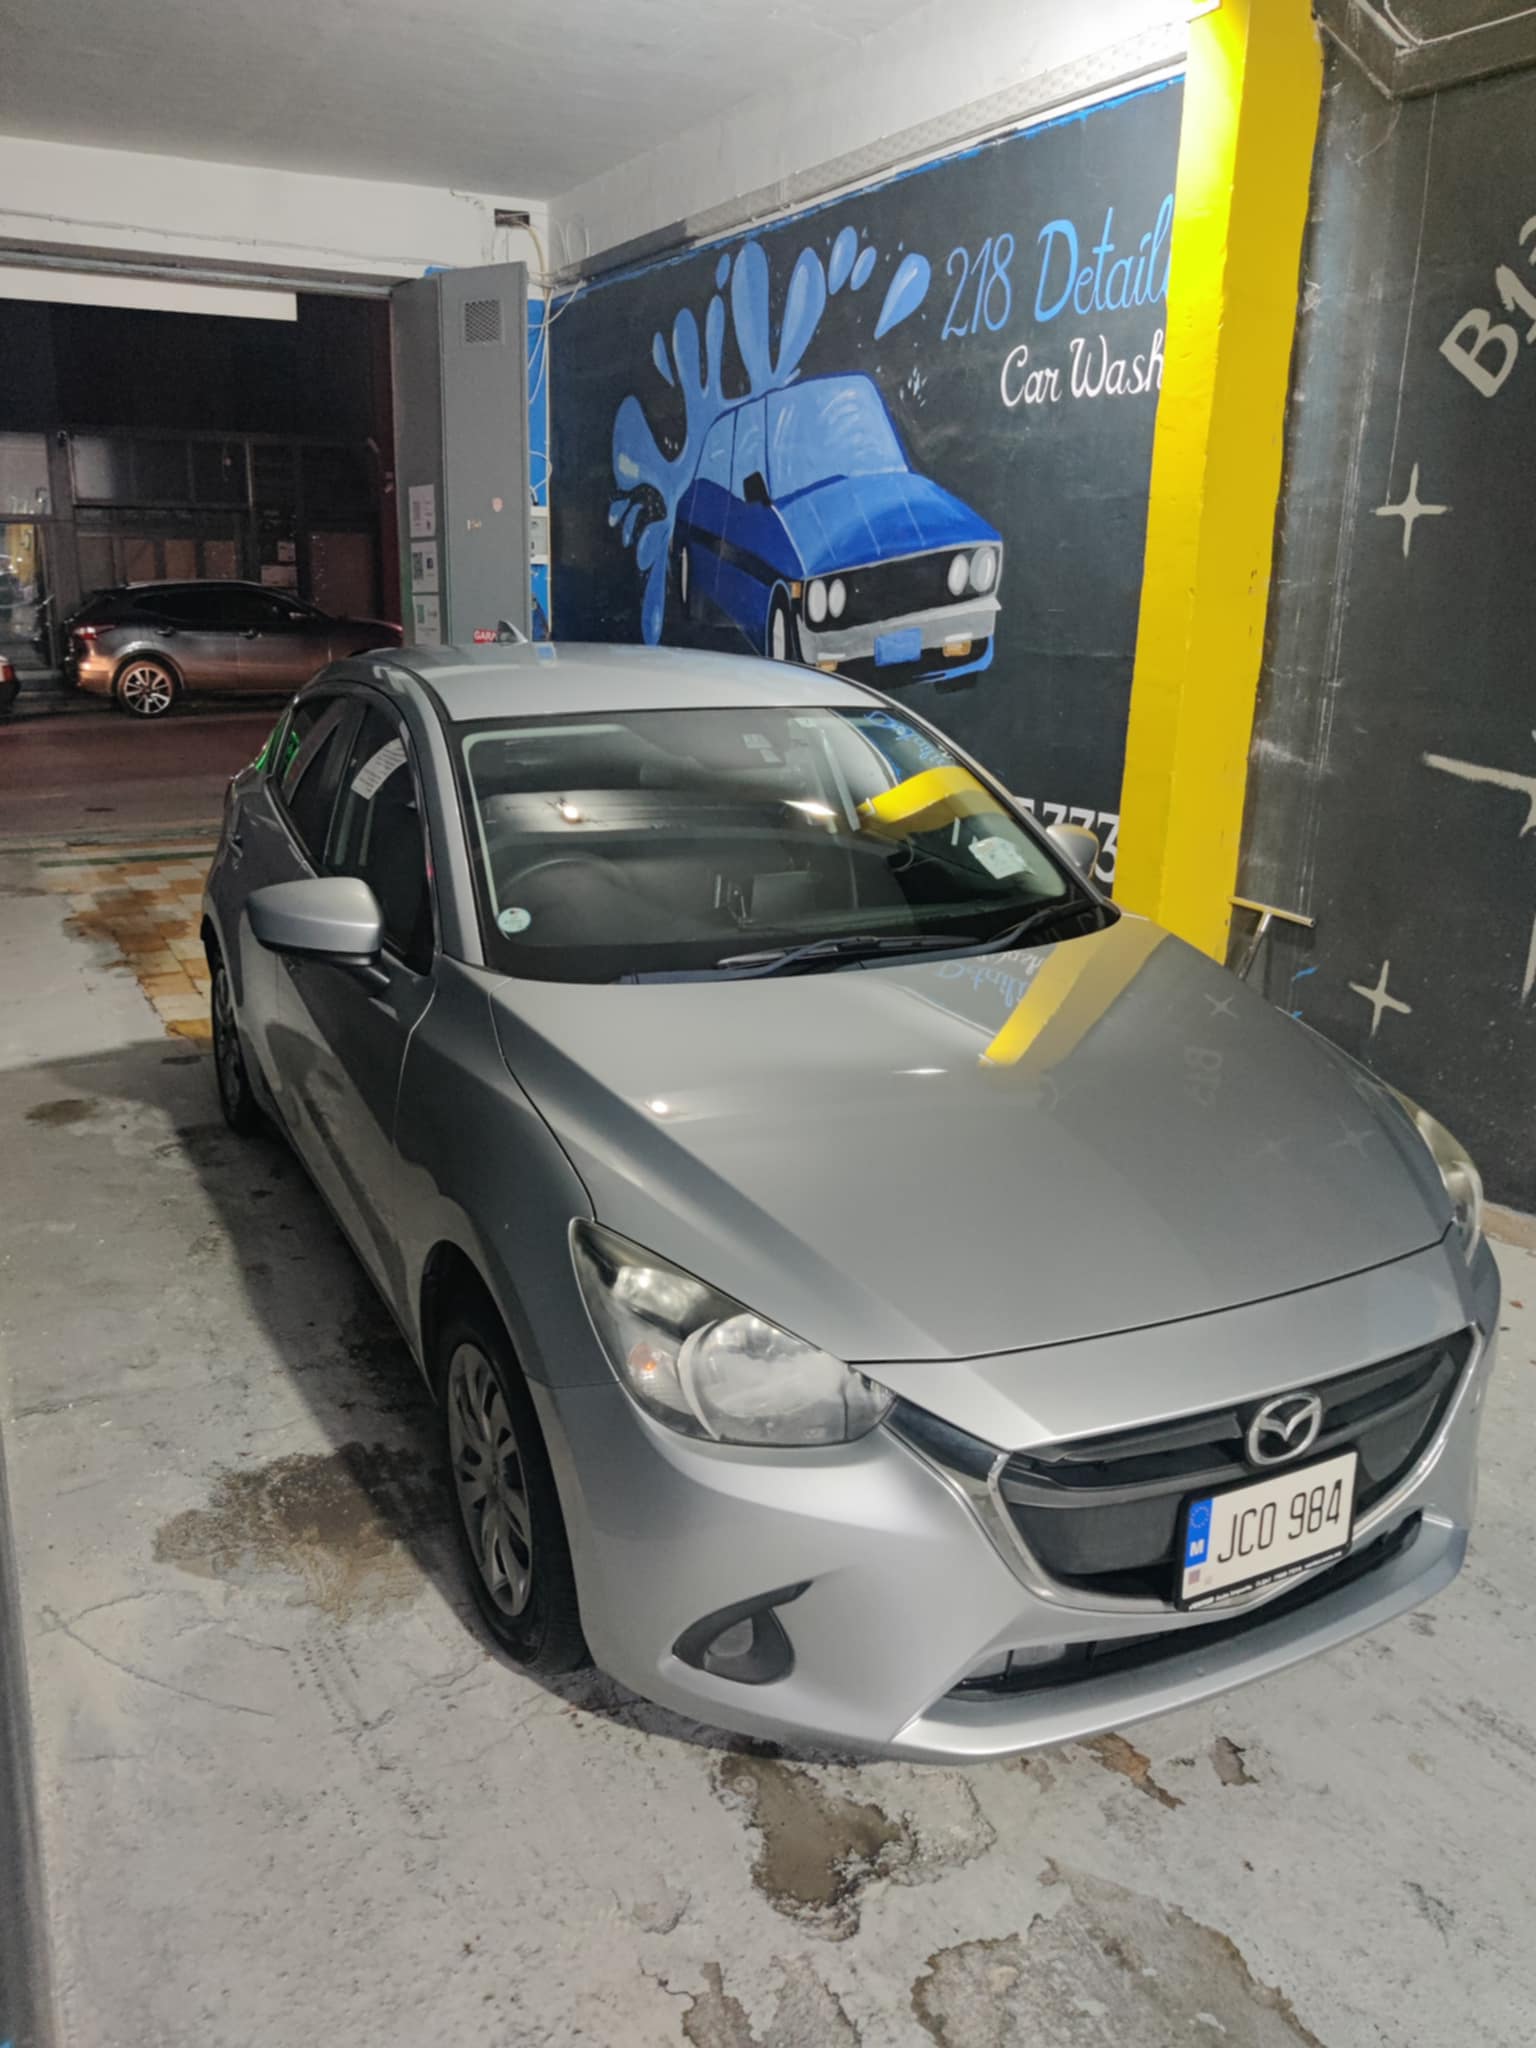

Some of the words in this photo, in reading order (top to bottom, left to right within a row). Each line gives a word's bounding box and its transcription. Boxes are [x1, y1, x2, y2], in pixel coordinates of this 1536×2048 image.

[941, 232, 1015, 341] 218
[1000, 344, 1064, 407] Car
[1070, 328, 1164, 398] Wash
[1217, 1502, 1277, 1563] JCO
[1288, 1478, 1343, 1540] 984
